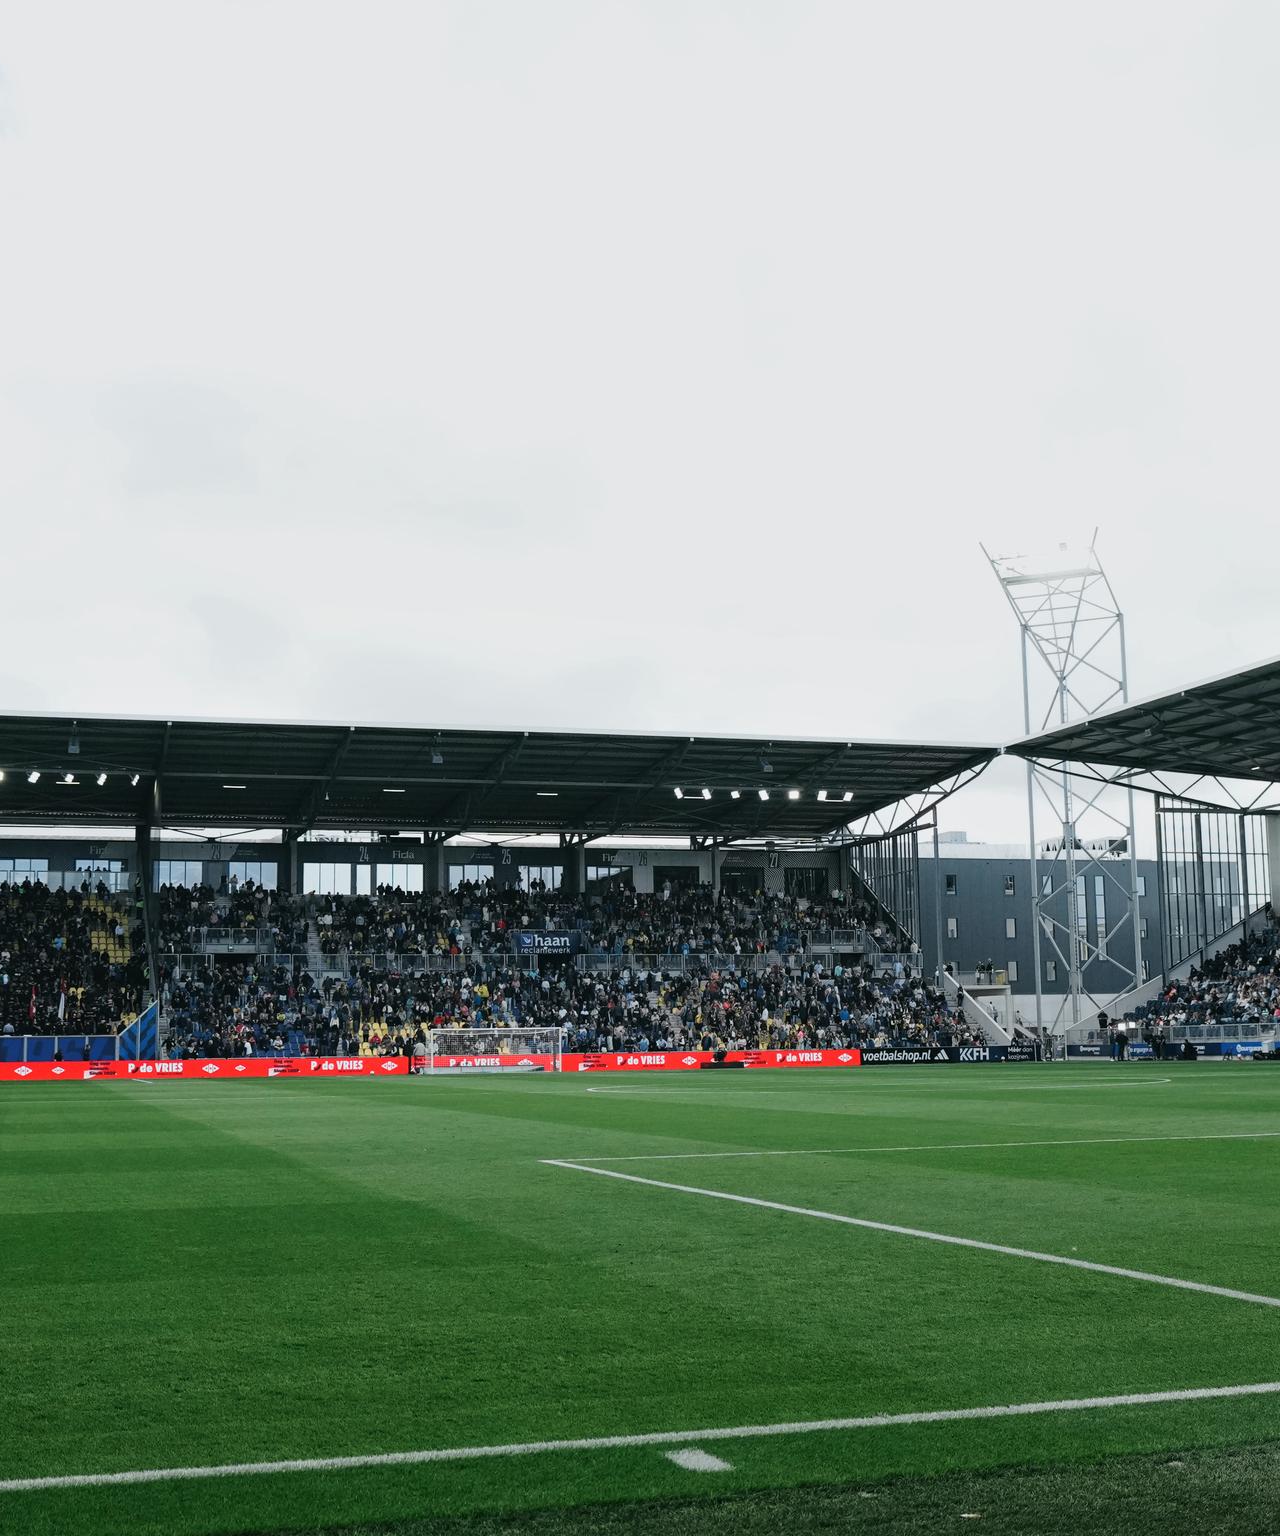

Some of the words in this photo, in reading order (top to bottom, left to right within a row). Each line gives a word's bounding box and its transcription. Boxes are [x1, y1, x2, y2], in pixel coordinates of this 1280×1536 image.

[359, 846, 369, 862] 24
[502, 850, 511, 865] 25
[534, 934, 570, 946] haan
[521, 946, 570, 954] reclamewerk
[627, 1055, 639, 1065] de
[640, 1055, 665, 1065] VRIES
[786, 1053, 797, 1062] de
[799, 1052, 823, 1062] VRIES
[862, 1049, 931, 1063] voetbalshop.nl
[139, 1063, 152, 1073] de
[154, 1062, 183, 1073] VRIES
[322, 1060, 335, 1071] de
[336, 1060, 363, 1070] VRIES
[474, 1058, 500, 1067] VRIES
